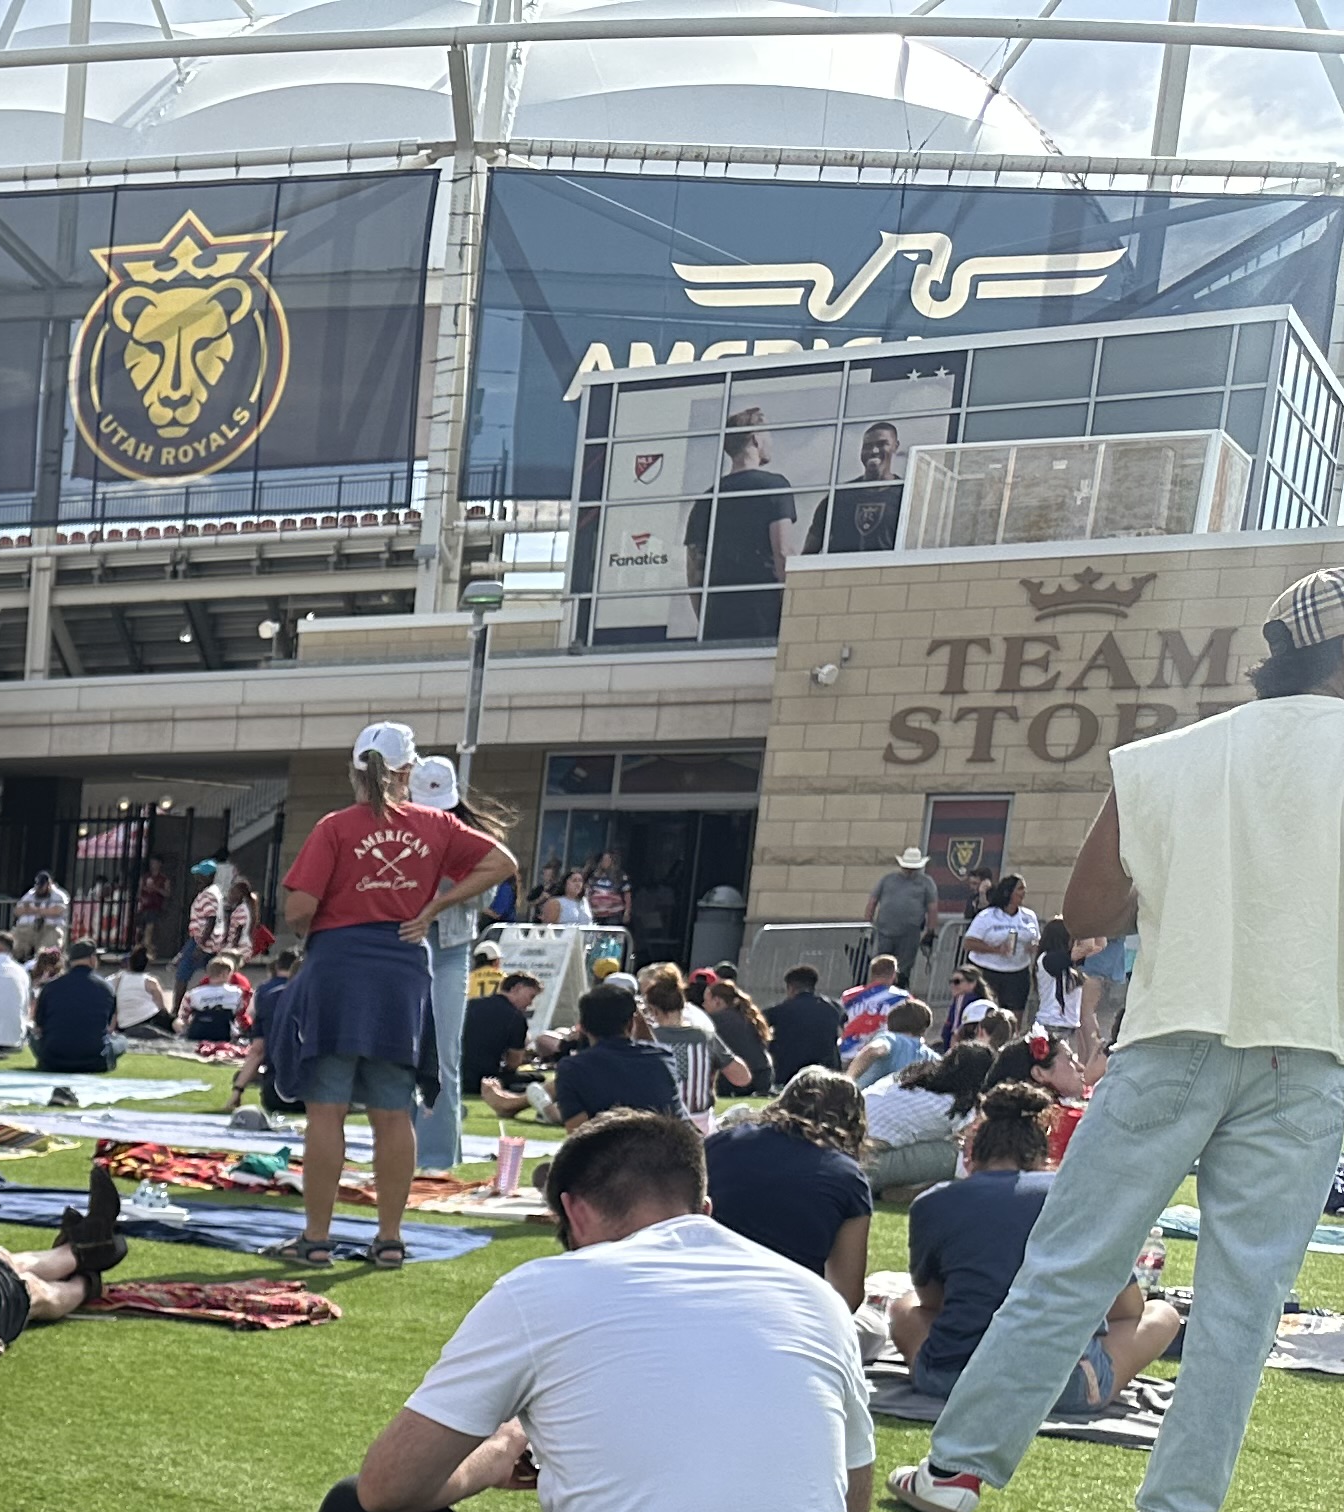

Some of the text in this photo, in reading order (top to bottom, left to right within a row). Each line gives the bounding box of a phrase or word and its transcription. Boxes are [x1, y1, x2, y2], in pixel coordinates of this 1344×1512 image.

[99, 406, 252, 466] UTAH ROYALS
[608, 552, 668, 567] Fanatics
[926, 627, 1238, 695] TEAM
[882, 702, 1250, 765] STOR
[354, 829, 430, 859] AMERICAN
